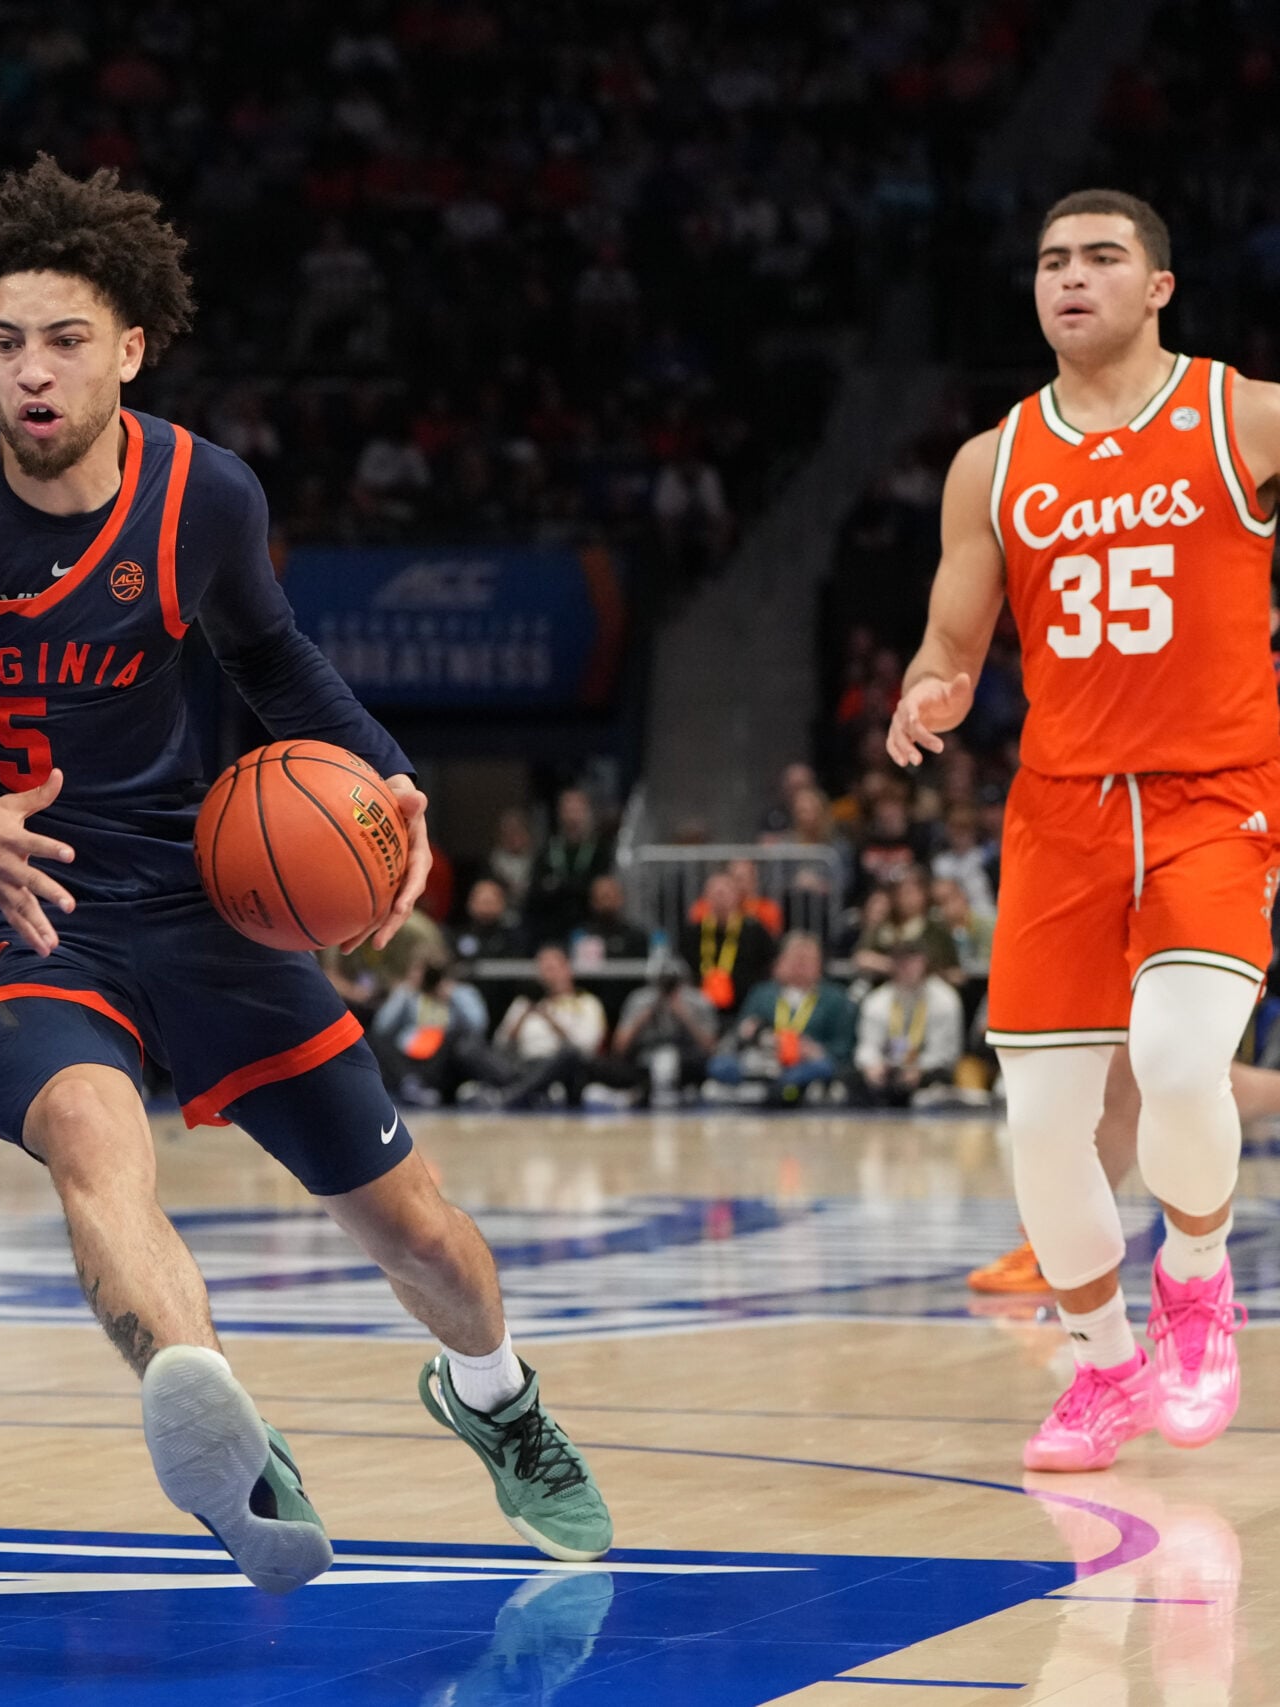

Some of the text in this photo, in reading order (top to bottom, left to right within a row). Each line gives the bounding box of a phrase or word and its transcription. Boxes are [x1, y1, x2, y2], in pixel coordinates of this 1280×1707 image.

[1013, 479, 1205, 550] Canes
[114, 572, 142, 585] ACC
[1047, 544, 1174, 658] 35
[350, 785, 404, 872] LEGAC
